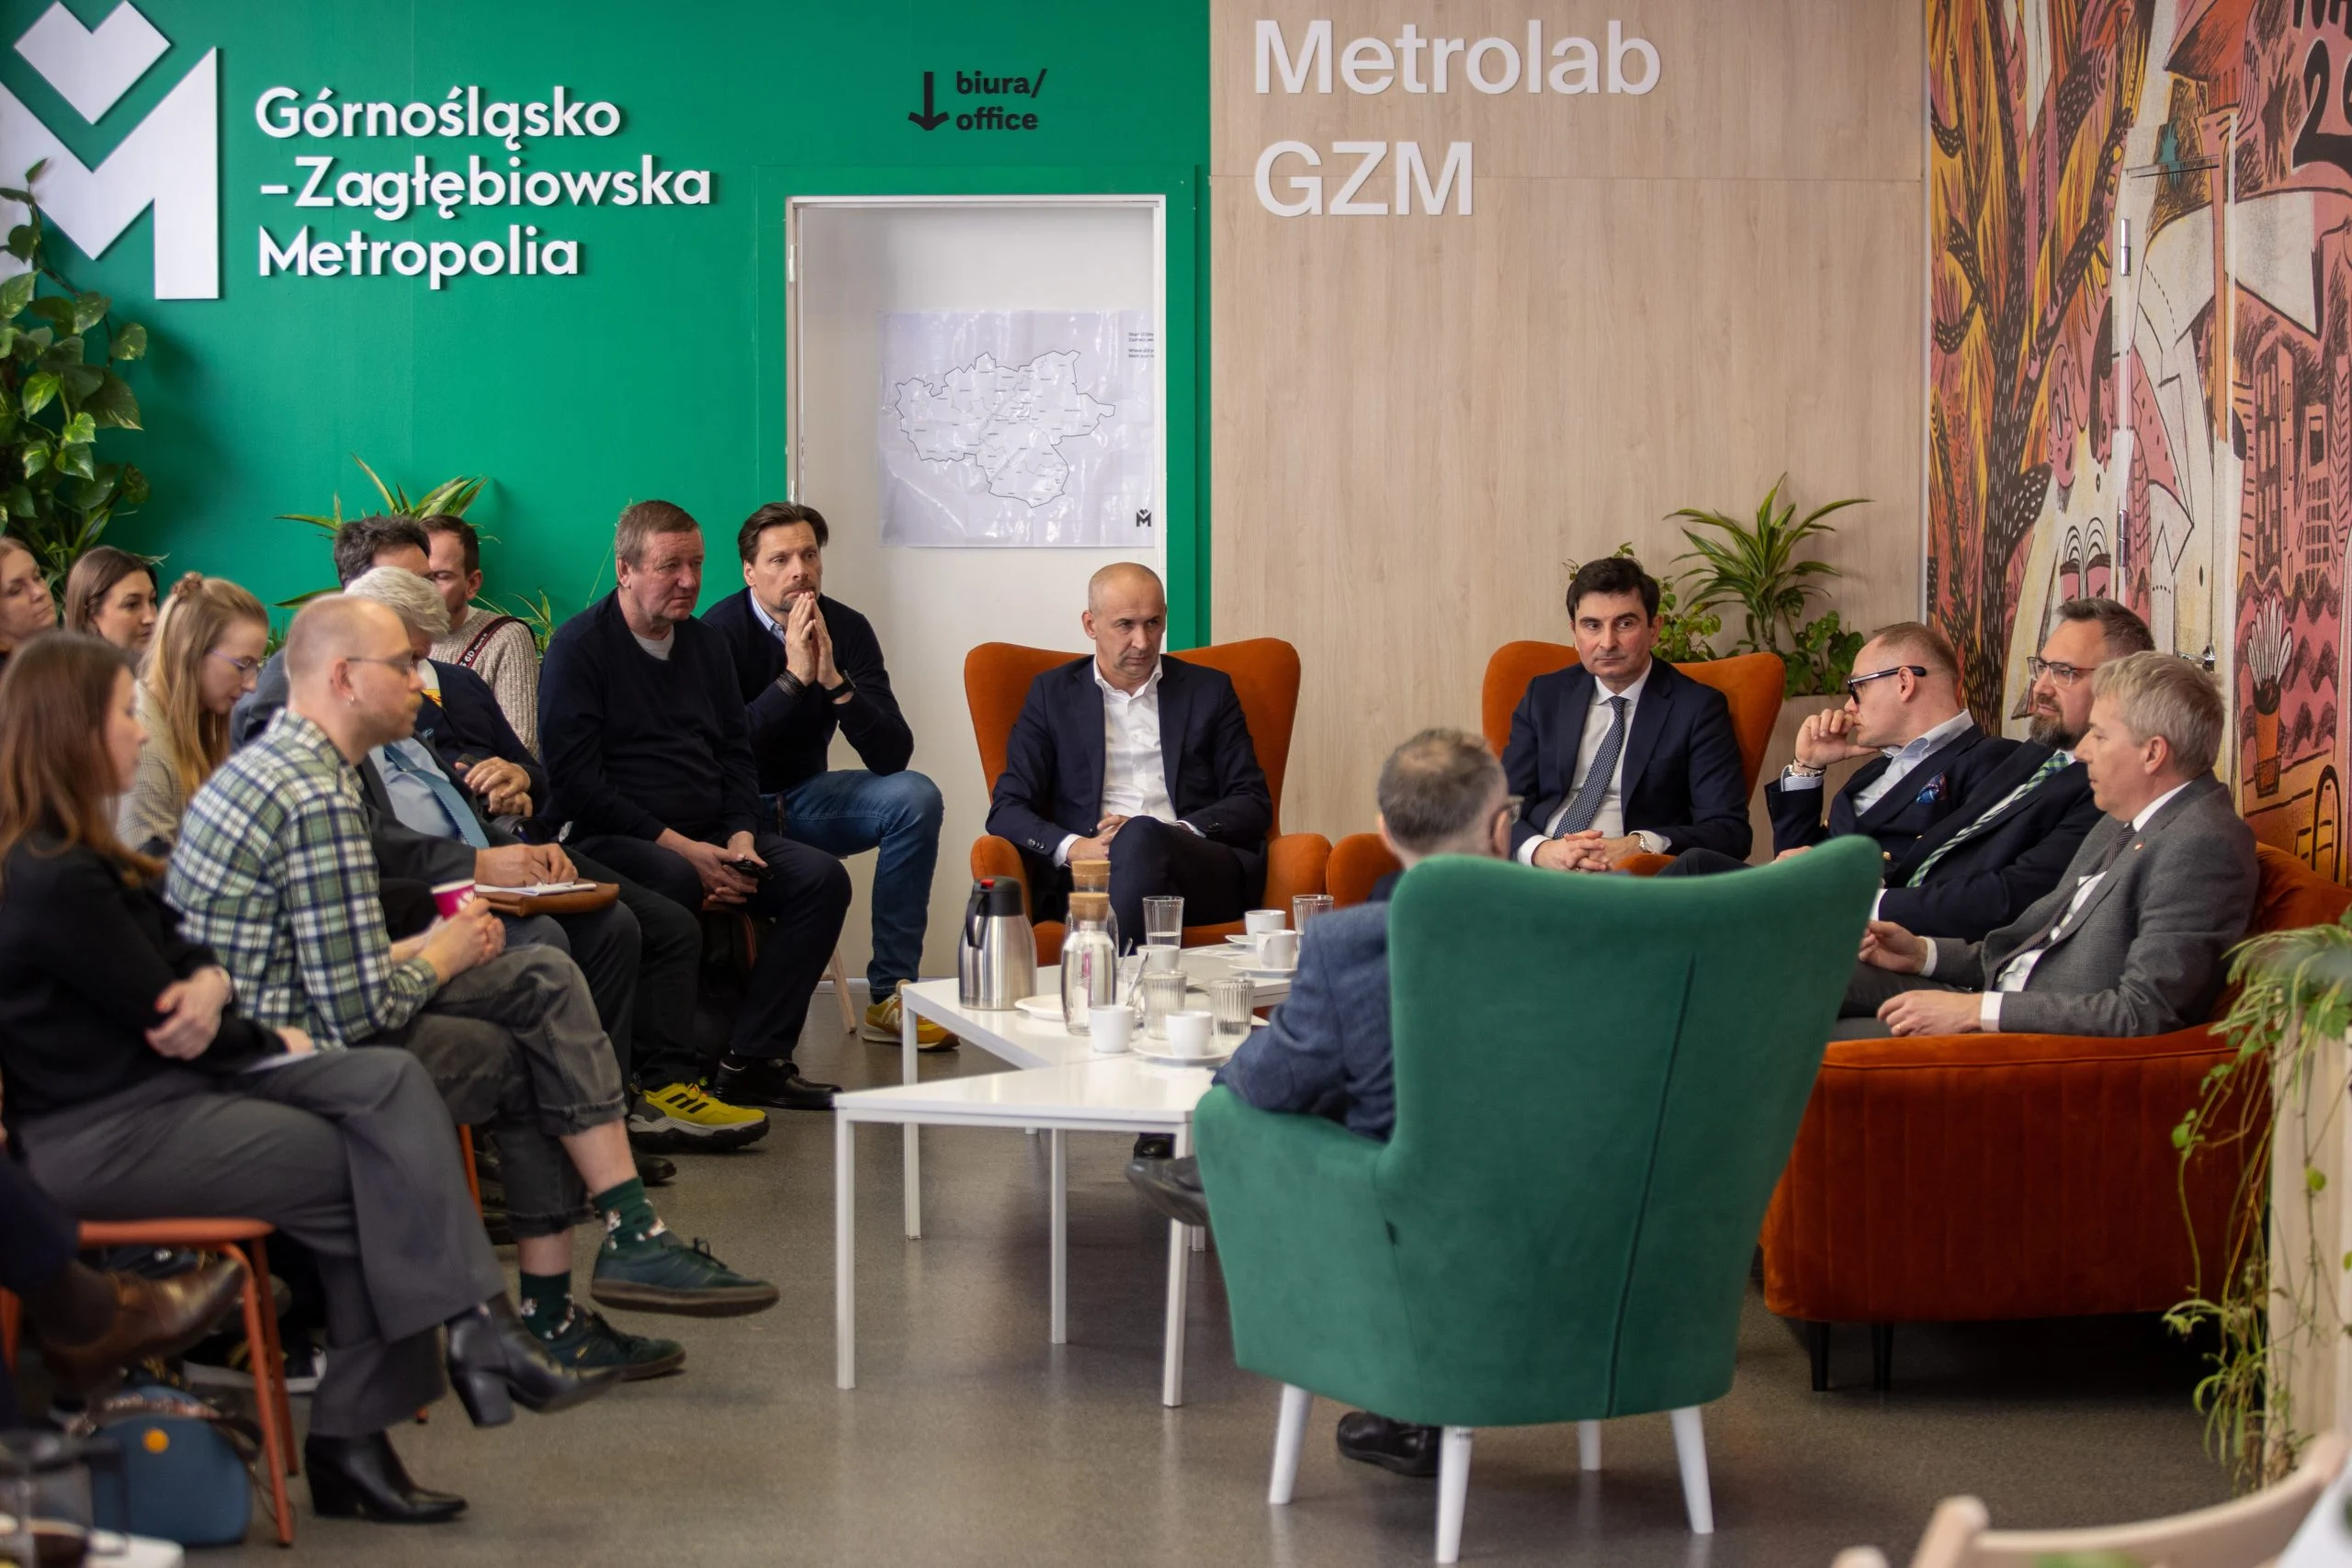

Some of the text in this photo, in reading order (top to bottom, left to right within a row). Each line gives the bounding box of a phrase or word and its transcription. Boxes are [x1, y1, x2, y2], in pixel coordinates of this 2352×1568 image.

[956, 68, 1047, 98] biura/
[1255, 19, 1661, 95] Metrolab
[254, 85, 621, 152] Górnośląsko
[956, 106, 1038, 130] office
[260, 154, 711, 221] -Zagłębiowska
[1254, 141, 1473, 217] GZM
[259, 224, 578, 290] Metropolia
[464, 650, 475, 662] 6D
